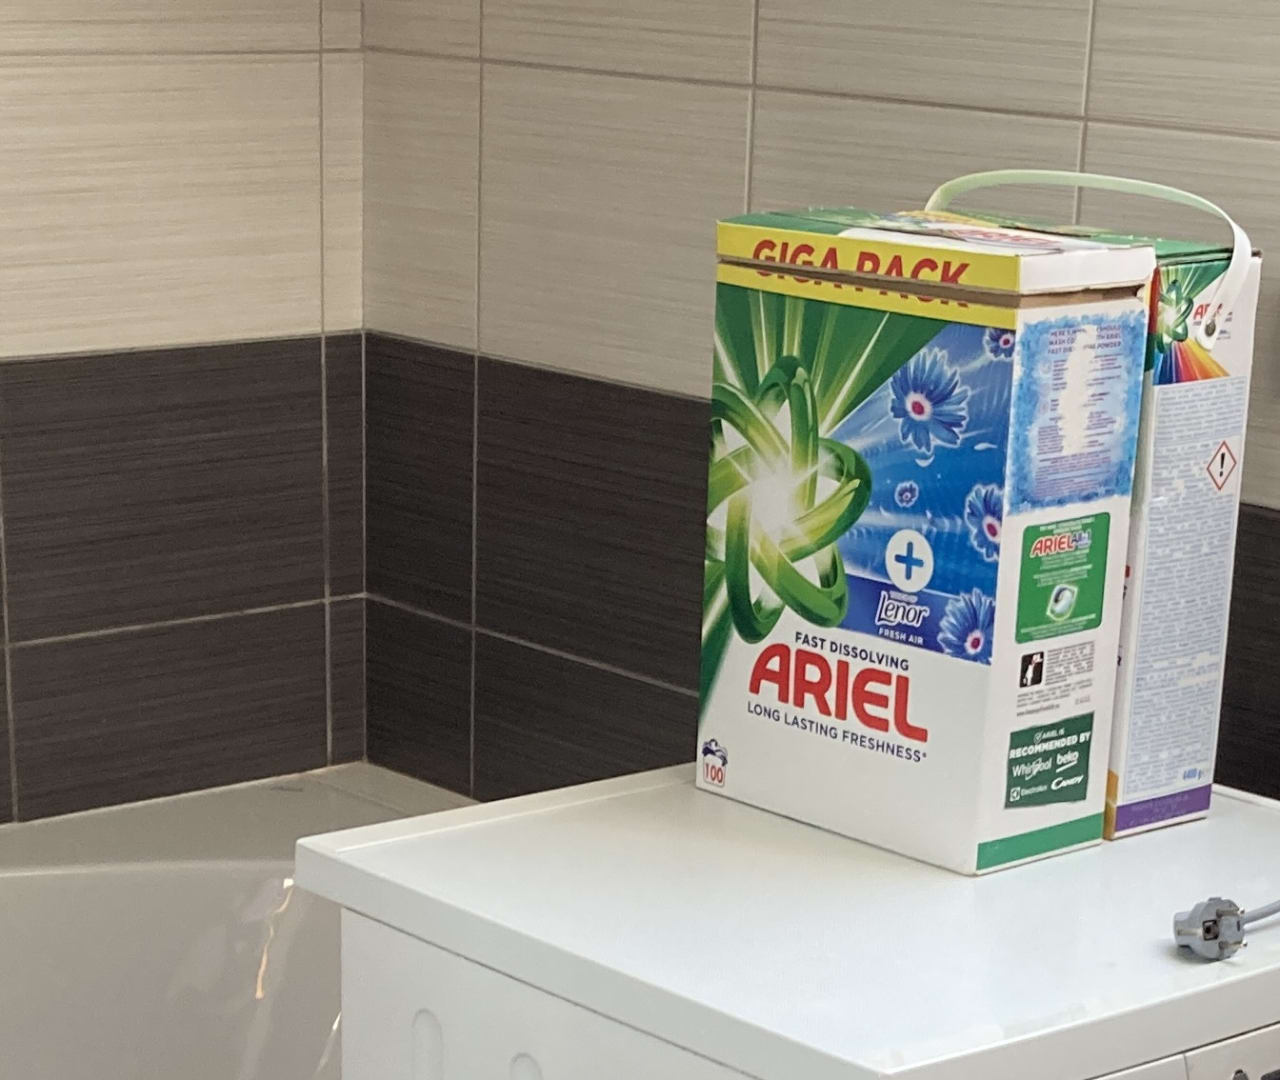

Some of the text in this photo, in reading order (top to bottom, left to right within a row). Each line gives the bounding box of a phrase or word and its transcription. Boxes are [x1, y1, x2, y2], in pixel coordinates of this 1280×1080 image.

[752, 239, 970, 308] GIGA PACK
[1031, 534, 1074, 556] ARIEL
[876, 591, 929, 627] Lenor
[795, 631, 909, 671] FAST DISSOLVING
[879, 628, 924, 645] FRESH AIR
[748, 643, 928, 743] ARIEL
[748, 701, 781, 722] LONG
[784, 711, 838, 739] LASTING
[1009, 731, 1091, 759] RECOMMENDED BY
[705, 763, 724, 783] 100
